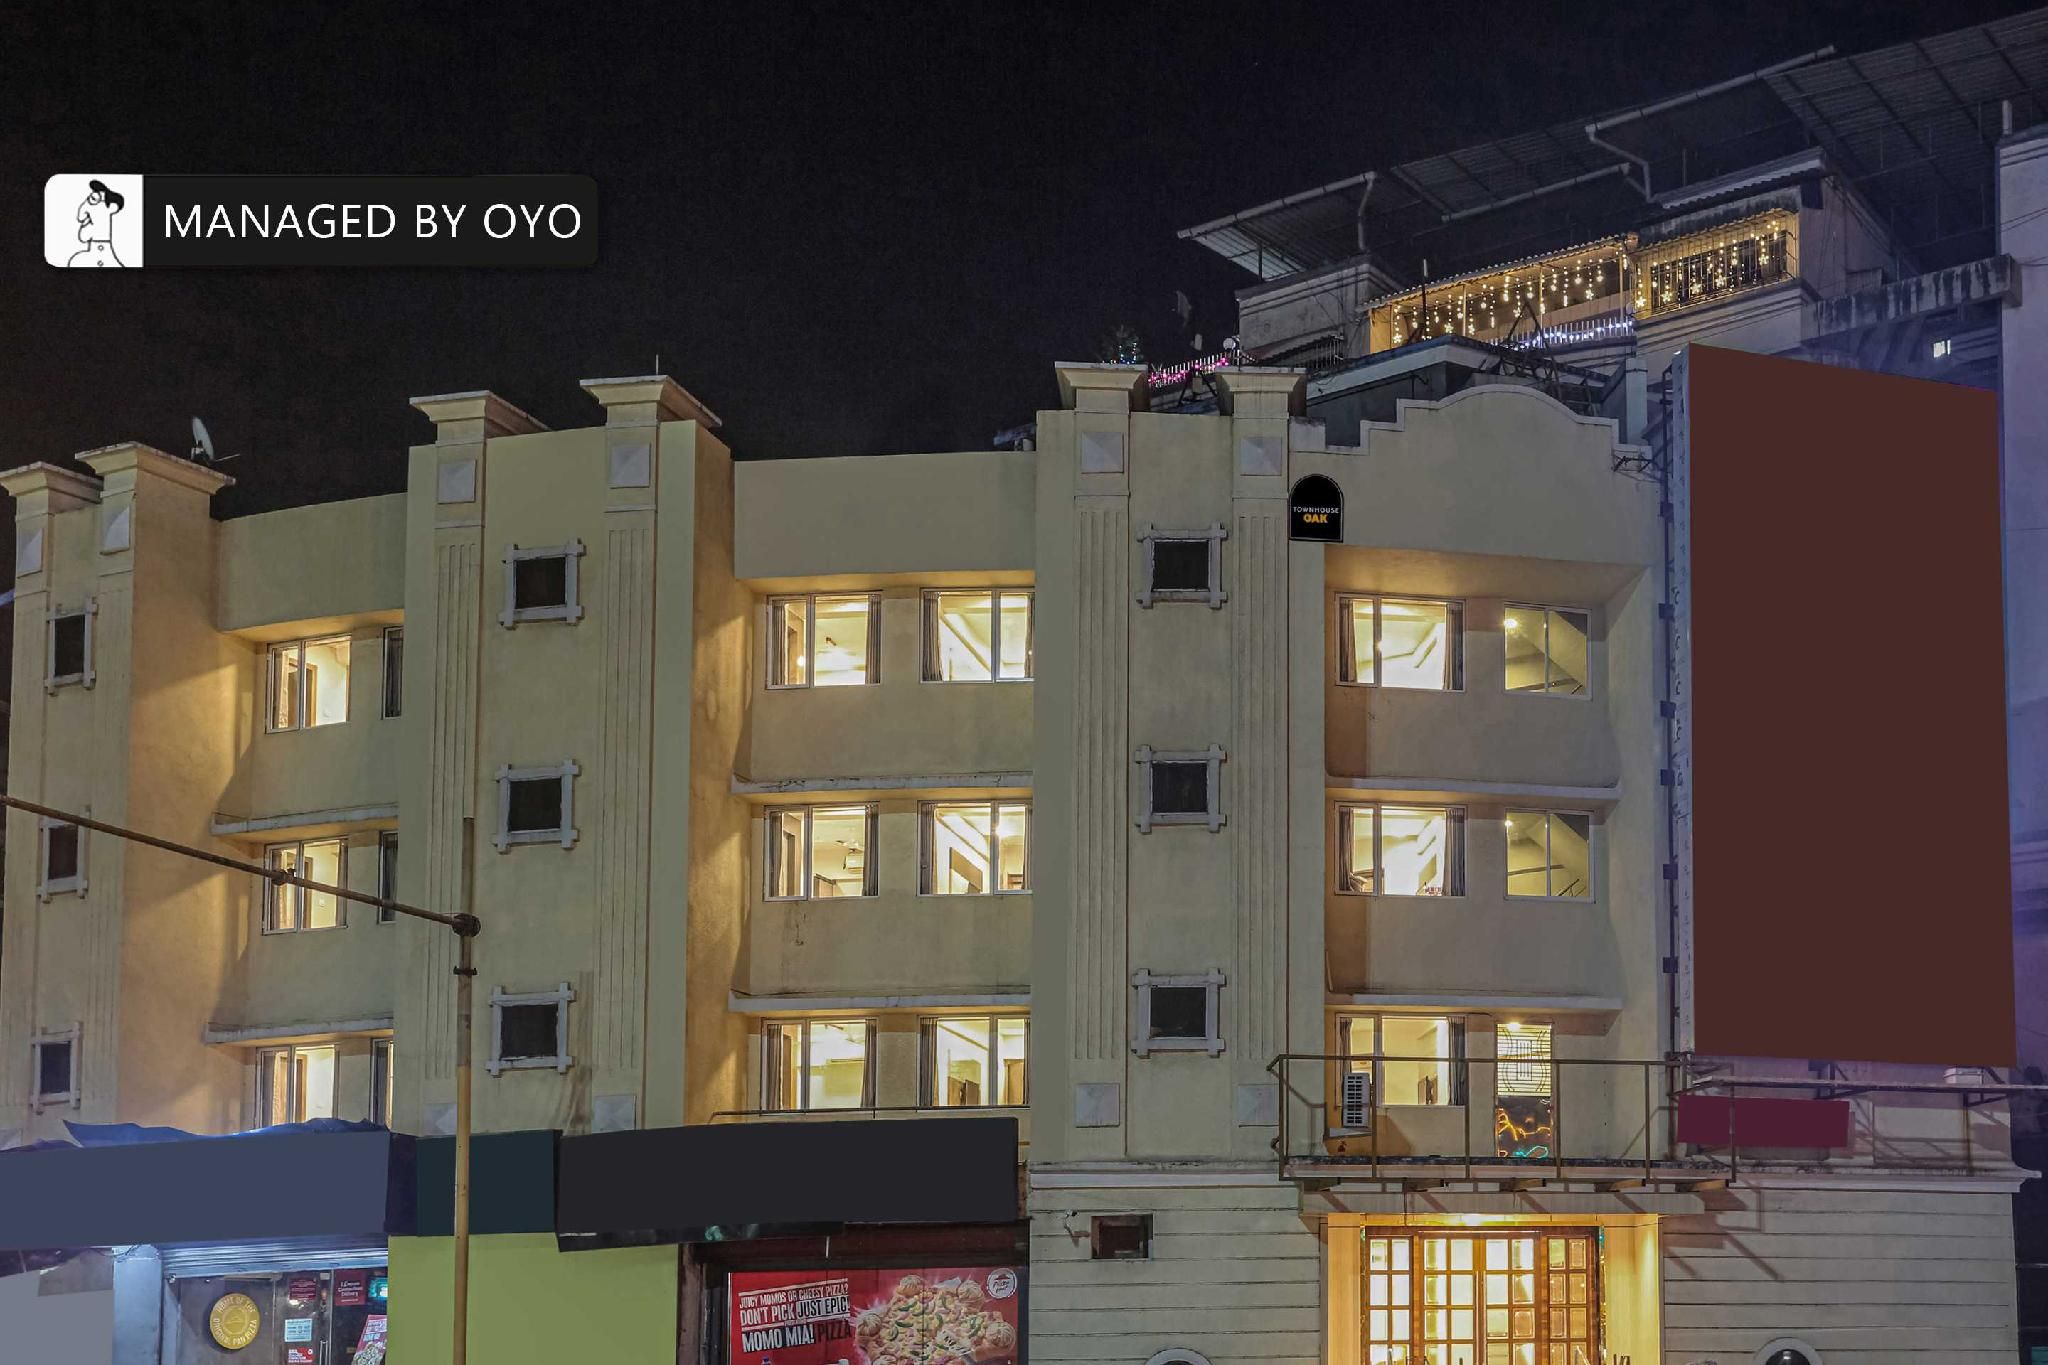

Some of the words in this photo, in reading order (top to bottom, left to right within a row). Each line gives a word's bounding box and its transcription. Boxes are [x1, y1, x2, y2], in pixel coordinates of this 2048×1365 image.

[1293, 506, 1340, 514] TOWNHOUSE
[1303, 513, 1328, 523] OAK
[740, 1295, 758, 1309] JUICY
[760, 1292, 787, 1306] MOMOS
[787, 1290, 797, 1302] OR
[799, 1287, 824, 1301] CHEESY
[826, 1283, 848, 1296] PIZZA?
[740, 1306, 768, 1326] DON'T
[771, 1302, 796, 1323] PICK
[798, 1299, 822, 1318] JUST
[825, 1296, 850, 1314] EPIC!
[742, 1328, 783, 1353] MOMO
[785, 1324, 815, 1347] MIA!
